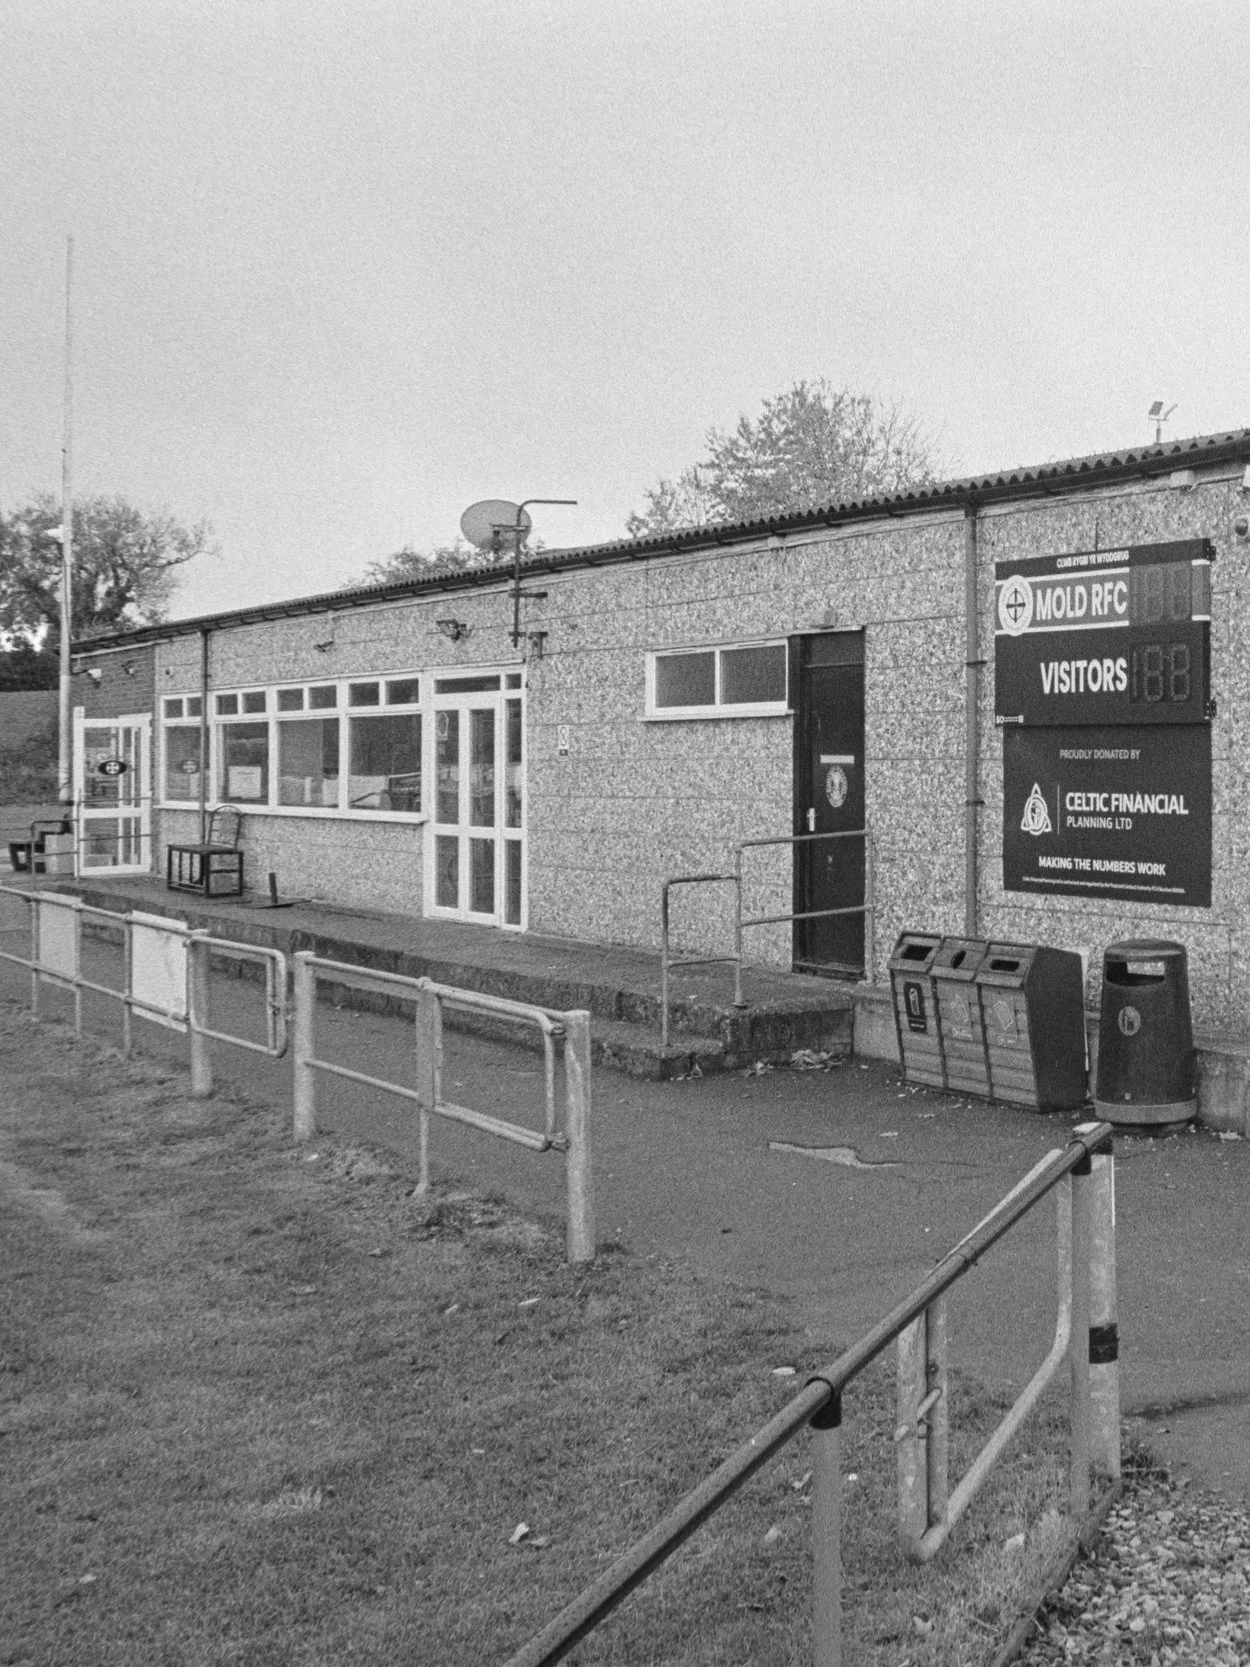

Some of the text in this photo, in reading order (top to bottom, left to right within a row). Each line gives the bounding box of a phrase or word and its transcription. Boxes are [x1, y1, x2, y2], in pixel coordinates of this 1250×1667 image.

[1035, 585, 1088, 621] MOLD
[1091, 580, 1128, 617] RFC
[1040, 657, 1128, 695] VISITORS
[1059, 748, 1141, 761] PROUDLY DONATED BY
[1065, 791, 1190, 816] CELTIC FINANCIAL
[1066, 815, 1132, 831] PLANNING LTD
[1038, 855, 1166, 877] MAKING THE NUMBERS WORK
